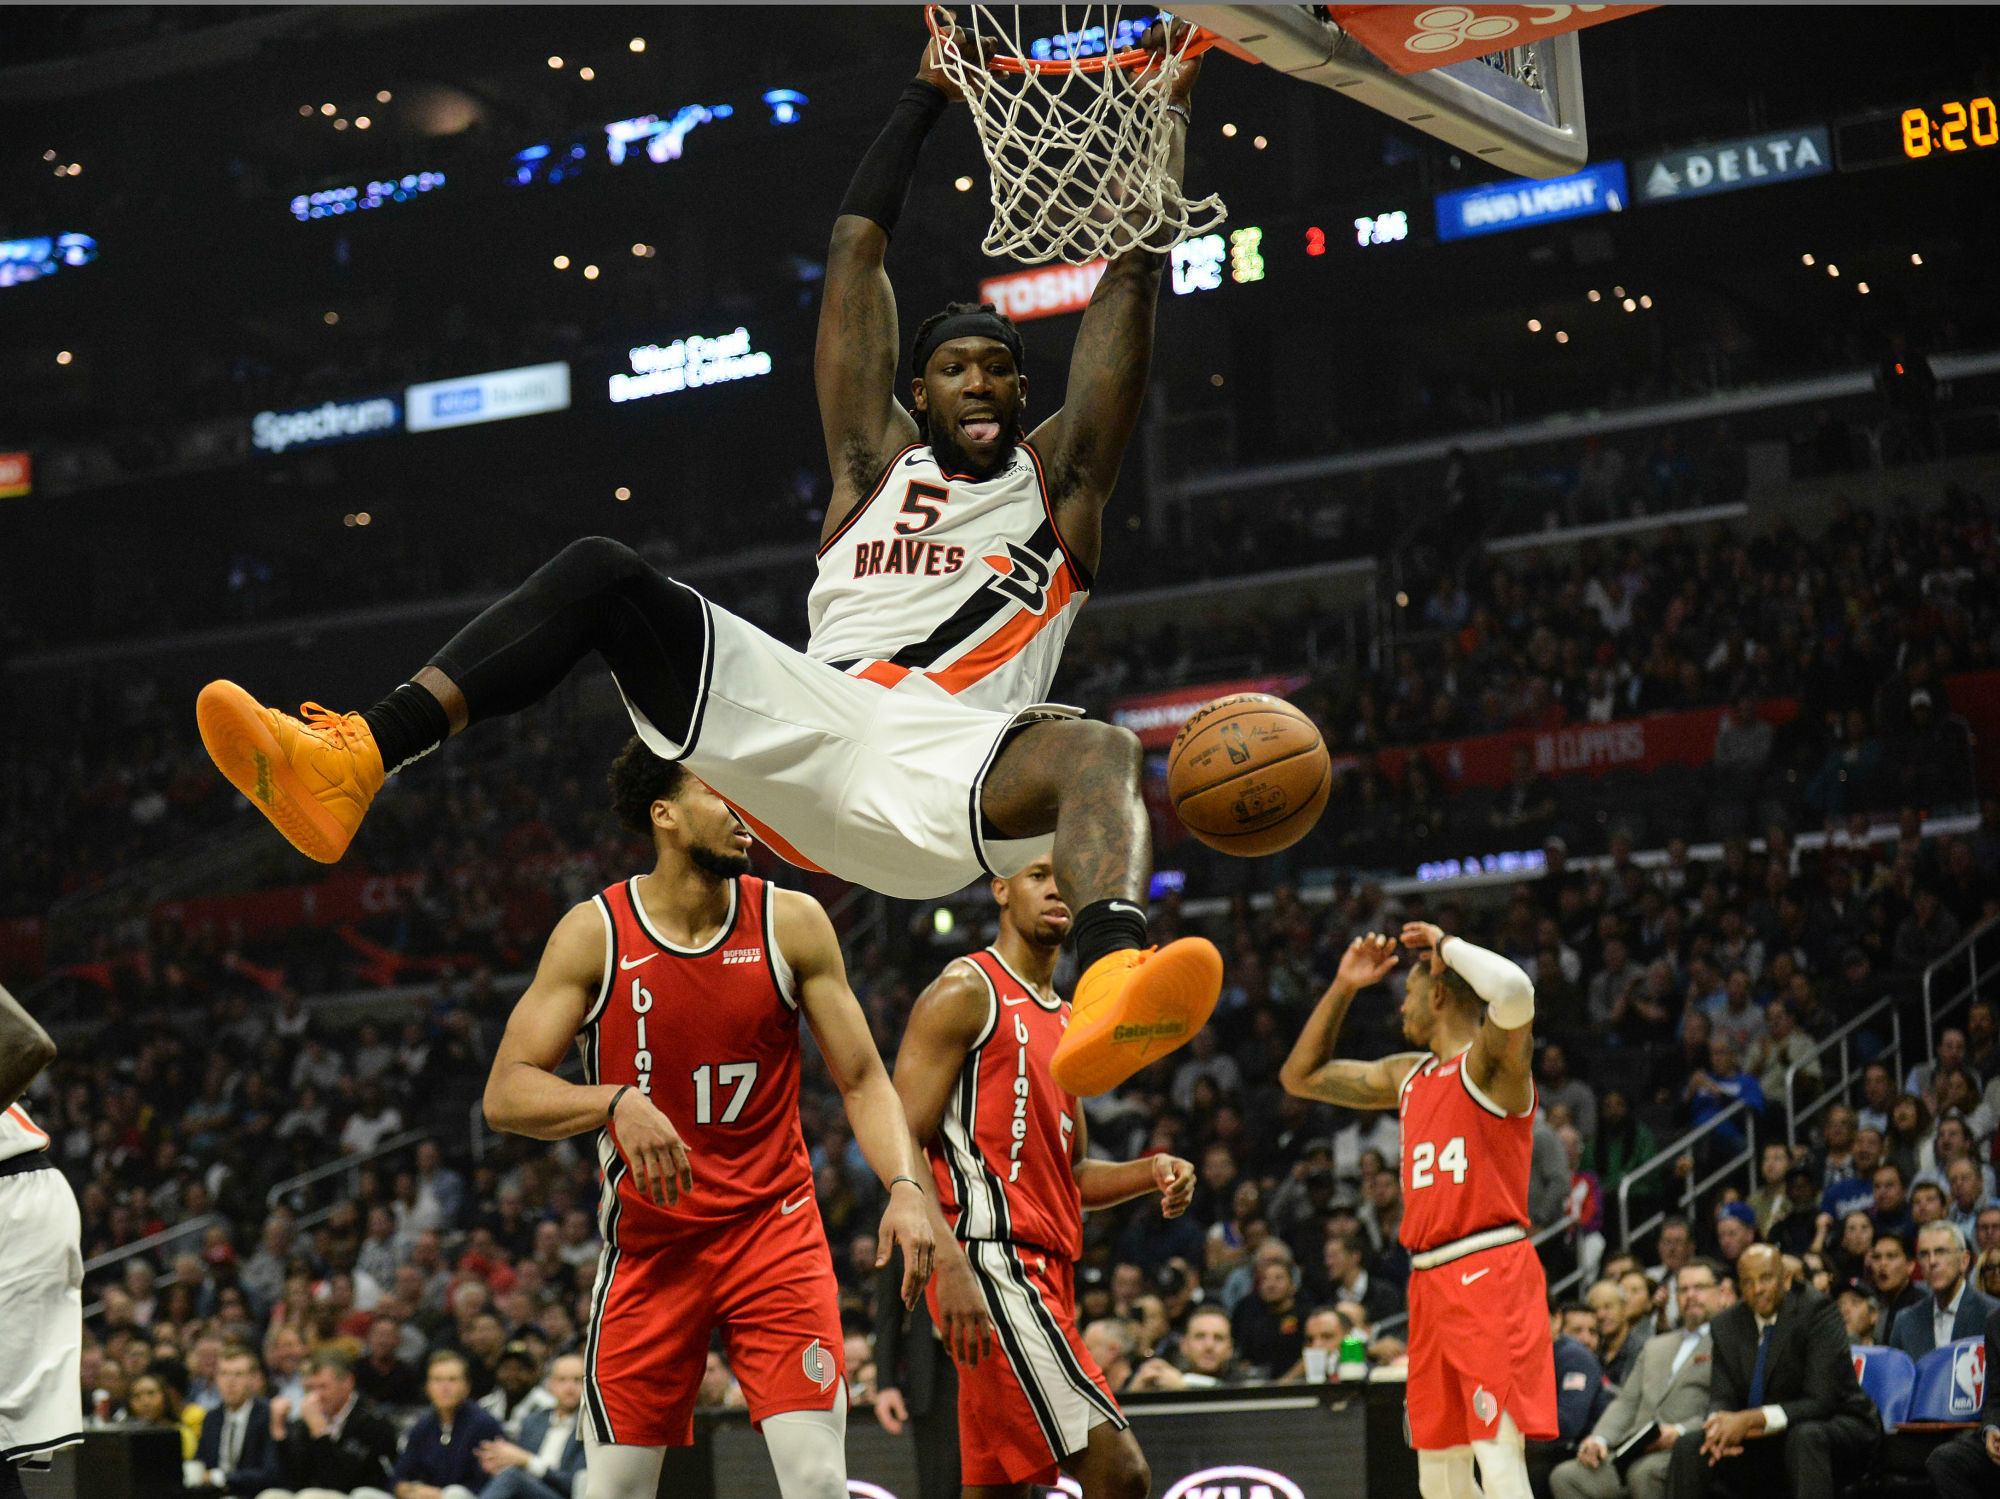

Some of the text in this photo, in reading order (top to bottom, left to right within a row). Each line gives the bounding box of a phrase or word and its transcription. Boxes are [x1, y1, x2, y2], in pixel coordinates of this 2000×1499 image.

[1901, 97, 1999, 158] 8:20
[1686, 136, 1823, 188] DELTA
[1462, 178, 1597, 227] BUD LIGHT
[982, 260, 1107, 316] TOSHI
[252, 398, 394, 453] Spectrum
[893, 479, 950, 535] 5
[853, 537, 966, 580] BRAVES
[723, 948, 761, 958] BIOFREEZE
[631, 976, 653, 1095] blaz
[692, 1060, 759, 1125] 17
[1008, 1013, 1030, 1183] blazers
[1412, 1136, 1469, 1190] 24
